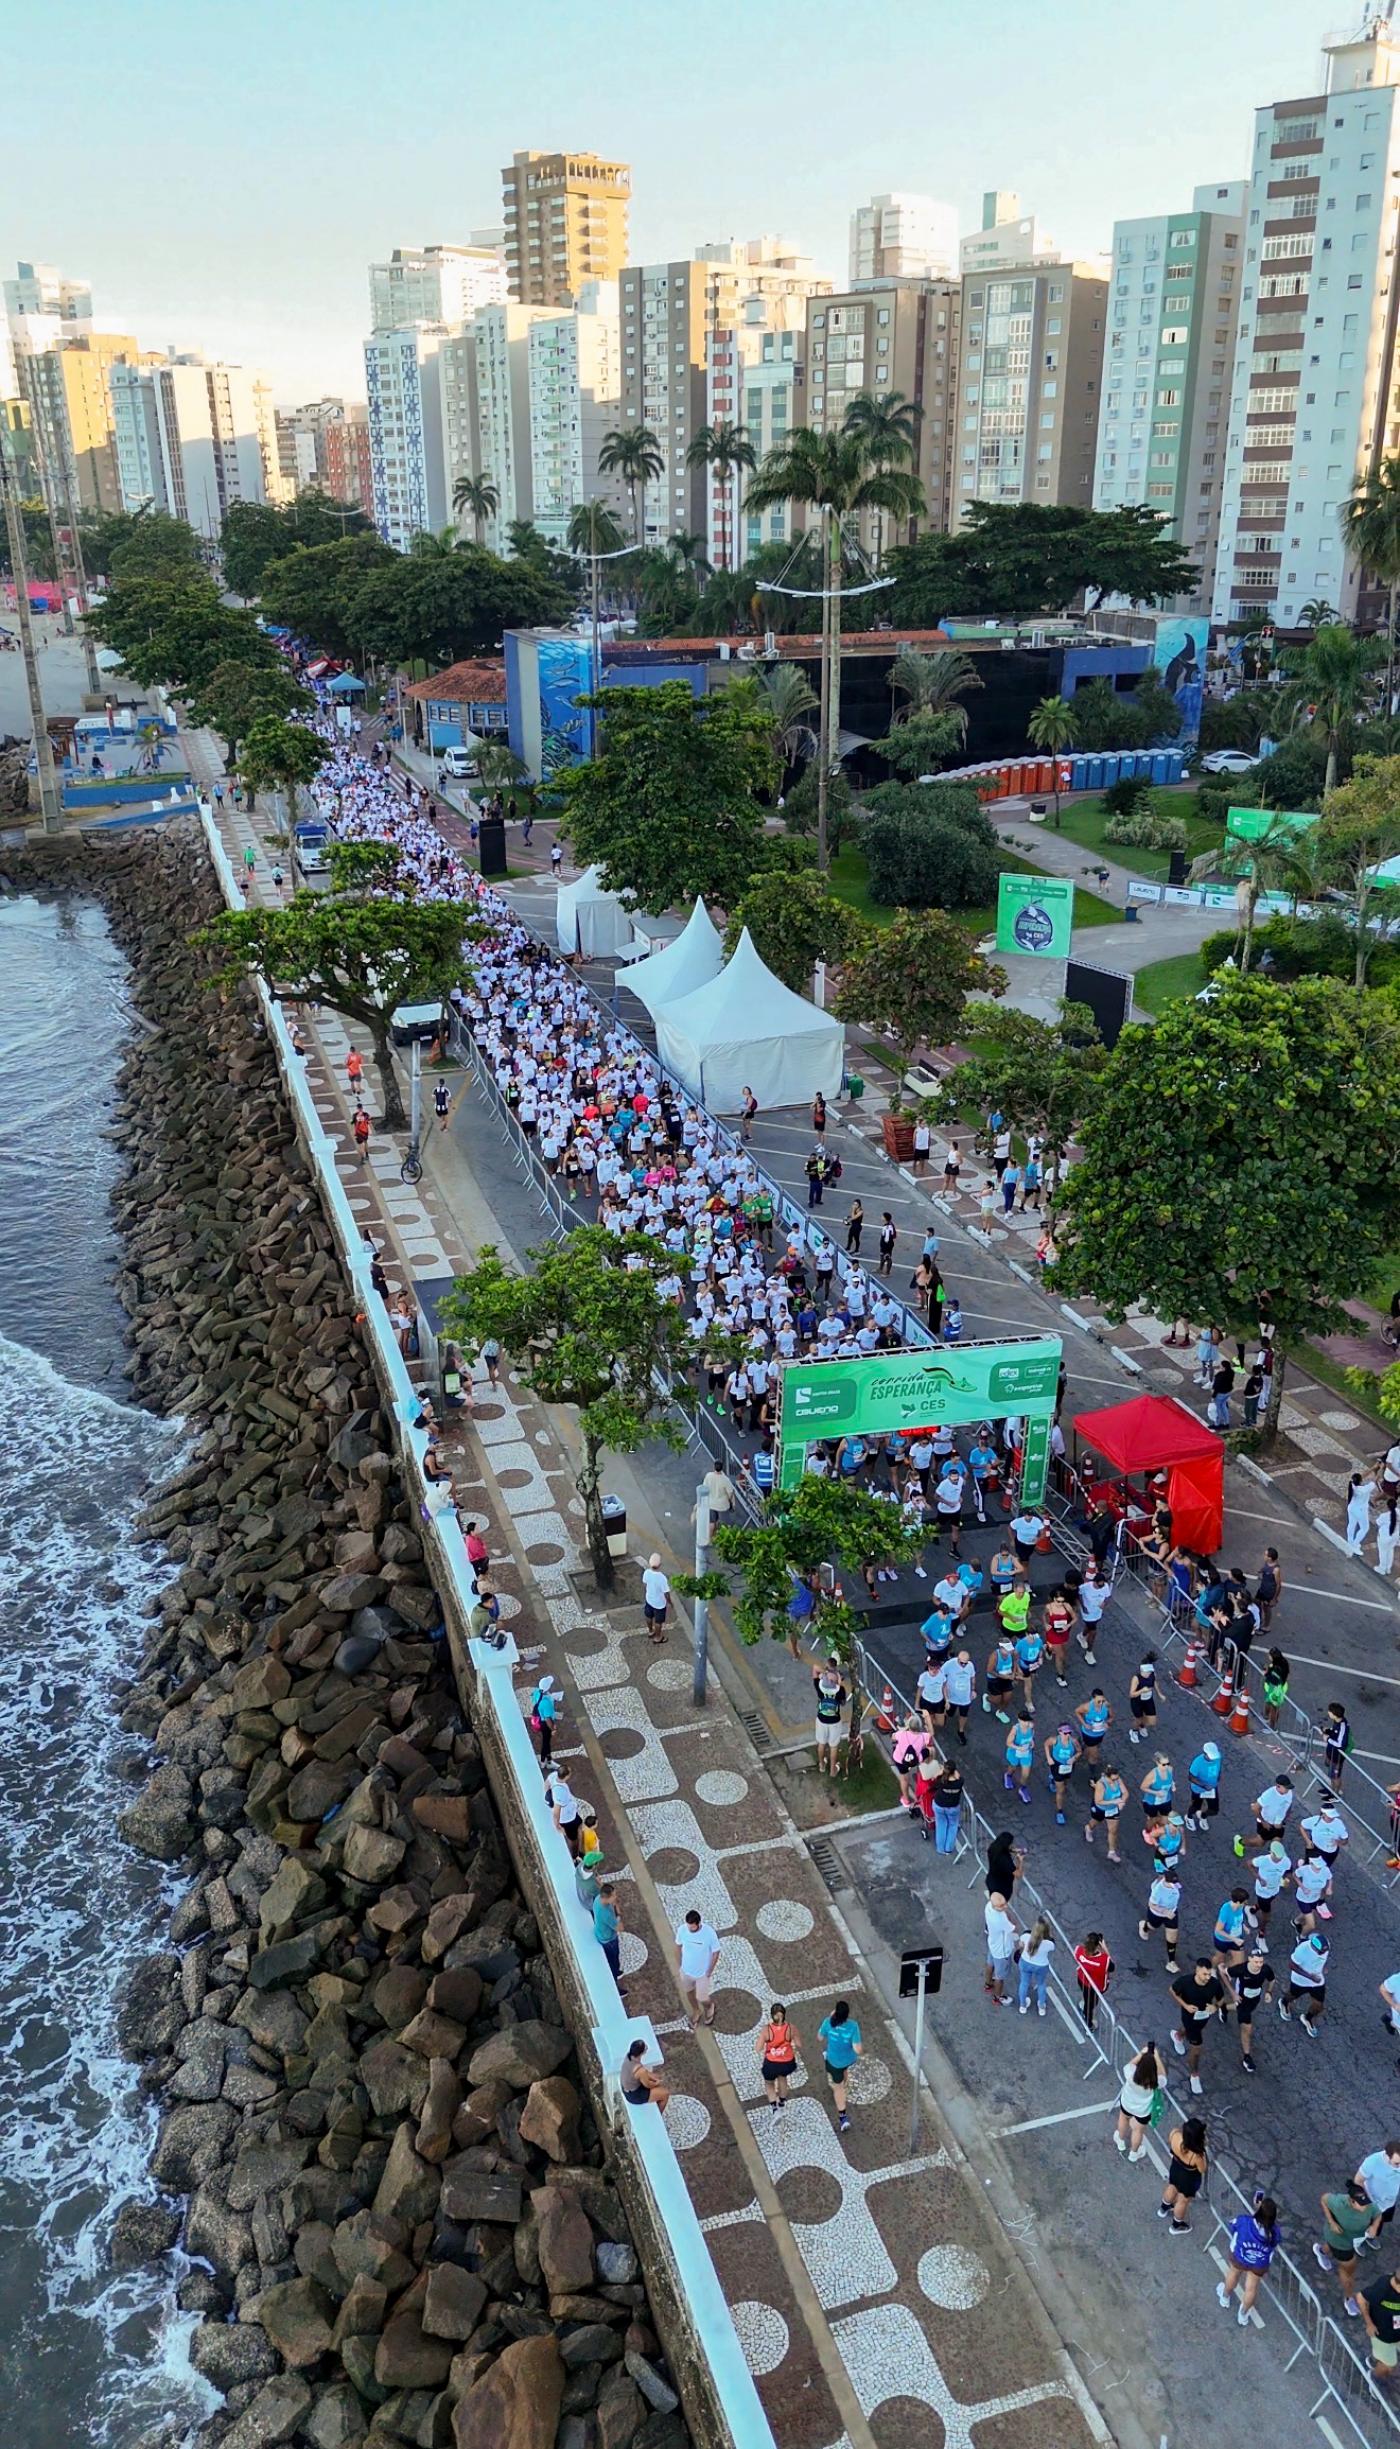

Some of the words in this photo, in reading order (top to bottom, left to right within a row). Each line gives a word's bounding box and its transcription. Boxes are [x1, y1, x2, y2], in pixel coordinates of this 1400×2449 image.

[871, 1371, 925, 1386] corrida
[870, 1380, 942, 1400] ESPERANÇA
[920, 1398, 946, 1411] CES
